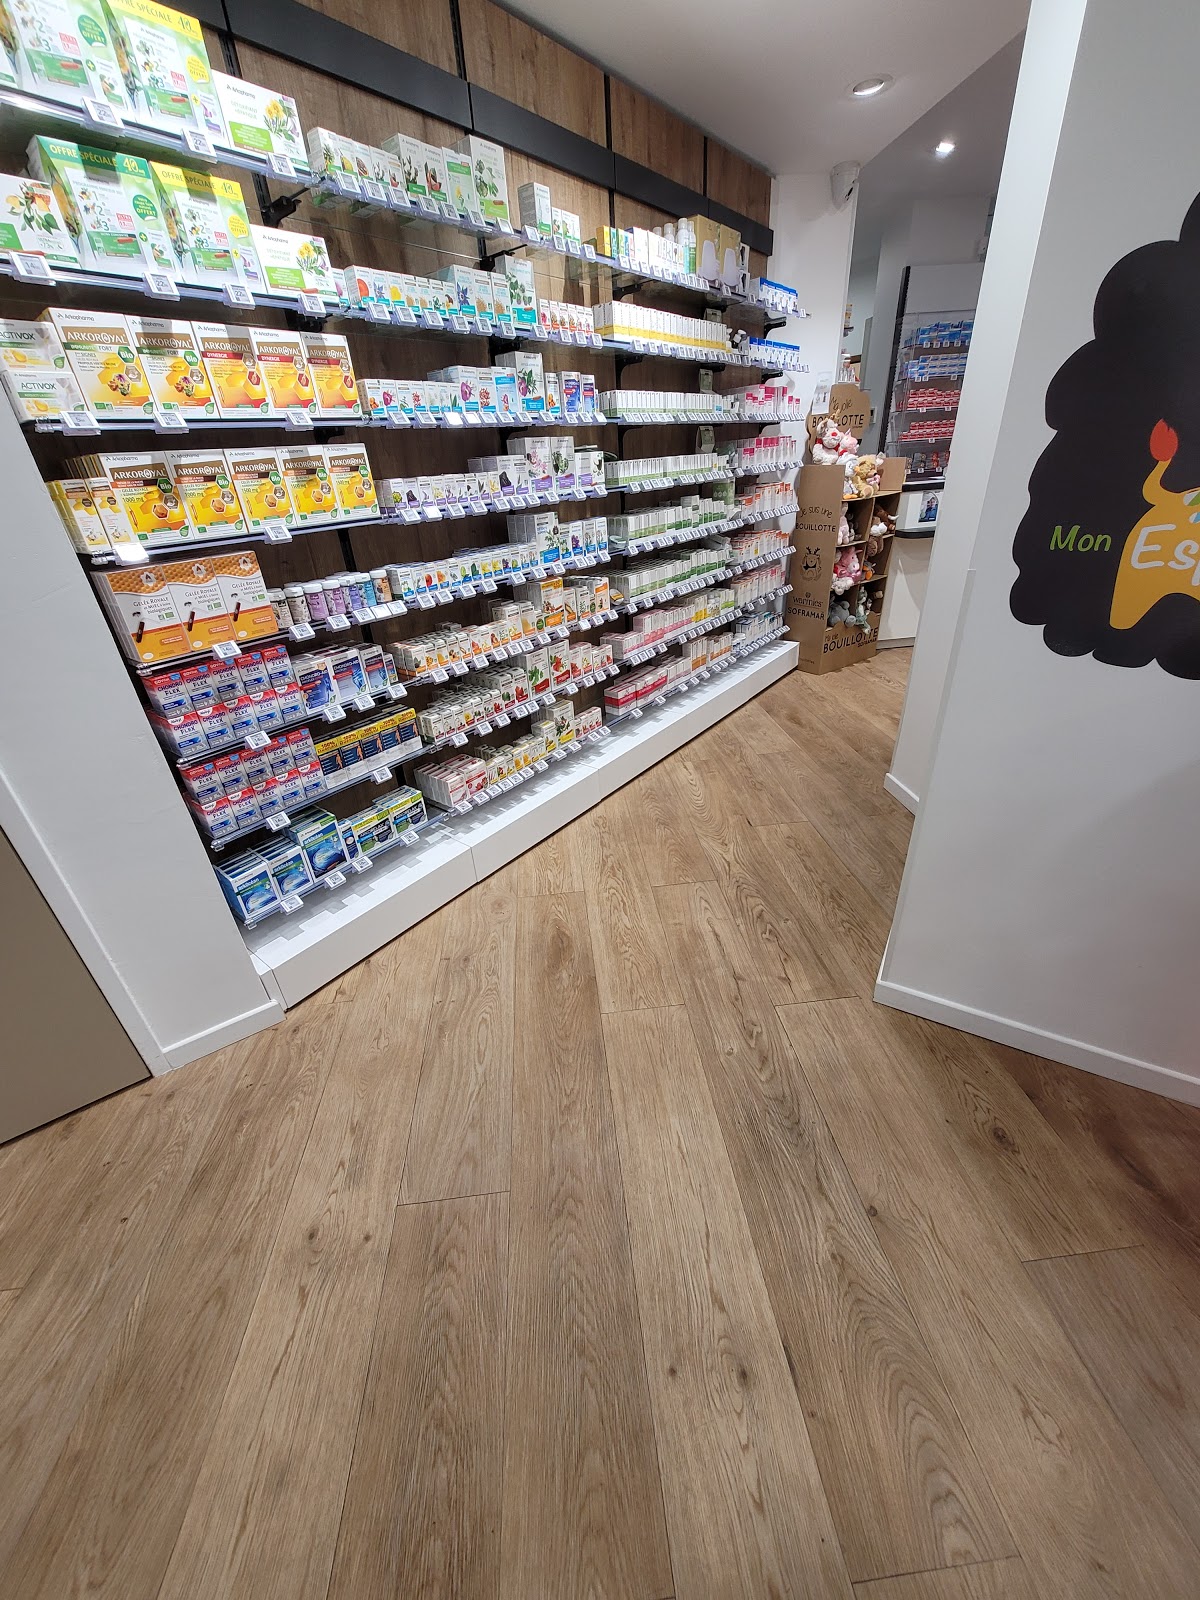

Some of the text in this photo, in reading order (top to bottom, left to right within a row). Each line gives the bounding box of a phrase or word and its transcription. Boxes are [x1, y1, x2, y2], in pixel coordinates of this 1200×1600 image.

[50, 144, 117, 166] OFFRE SPÉCIALE
[0, 332, 36, 340] ACTIVOX
[21, 382, 57, 390] ACTIVOX
[114, 468, 167, 479] ARKOROYAL
[808, 506, 820, 514] suis
[821, 507, 833, 519] une
[796, 522, 837, 533] BOUILLOTTE
[1050, 523, 1200, 586] Mon Es
[147, 606, 173, 614] biologiques
[787, 606, 825, 620] SOFRAMAR
[266, 653, 288, 663] CHONDRO
[240, 659, 263, 670] CHONDRO
[212, 666, 236, 676] CHONDRO
[186, 673, 210, 684] CHONDRO
[158, 681, 183, 692] CHONDRO
[164, 688, 180, 696] FLEX
[278, 689, 299, 699] CHONDRO
[254, 696, 276, 706] CHONDRO
[228, 703, 251, 713] CHONDRO
[202, 712, 226, 722] CHONDRO
[173, 720, 198, 731] CHONDRO
[180, 726, 195, 735] FLEX
[291, 735, 310, 746] CHONDRO
[268, 743, 288, 754] CHONDRO
[244, 752, 265, 763] CHONDRO
[249, 758, 263, 766] FLEX
[219, 761, 240, 772] CHONDRO
[224, 767, 239, 775] FLEX
[192, 770, 216, 782] CHONDRO
[301, 768, 320, 778] CHONDRO
[199, 776, 213, 784] FLEX
[280, 776, 299, 786] CHONDRO
[256, 785, 277, 796] CHONDRO
[262, 791, 275, 799] FLEX
[232, 794, 254, 806] CHONDRO
[206, 804, 229, 816] CHONDRO
[212, 810, 226, 819] FLEX
